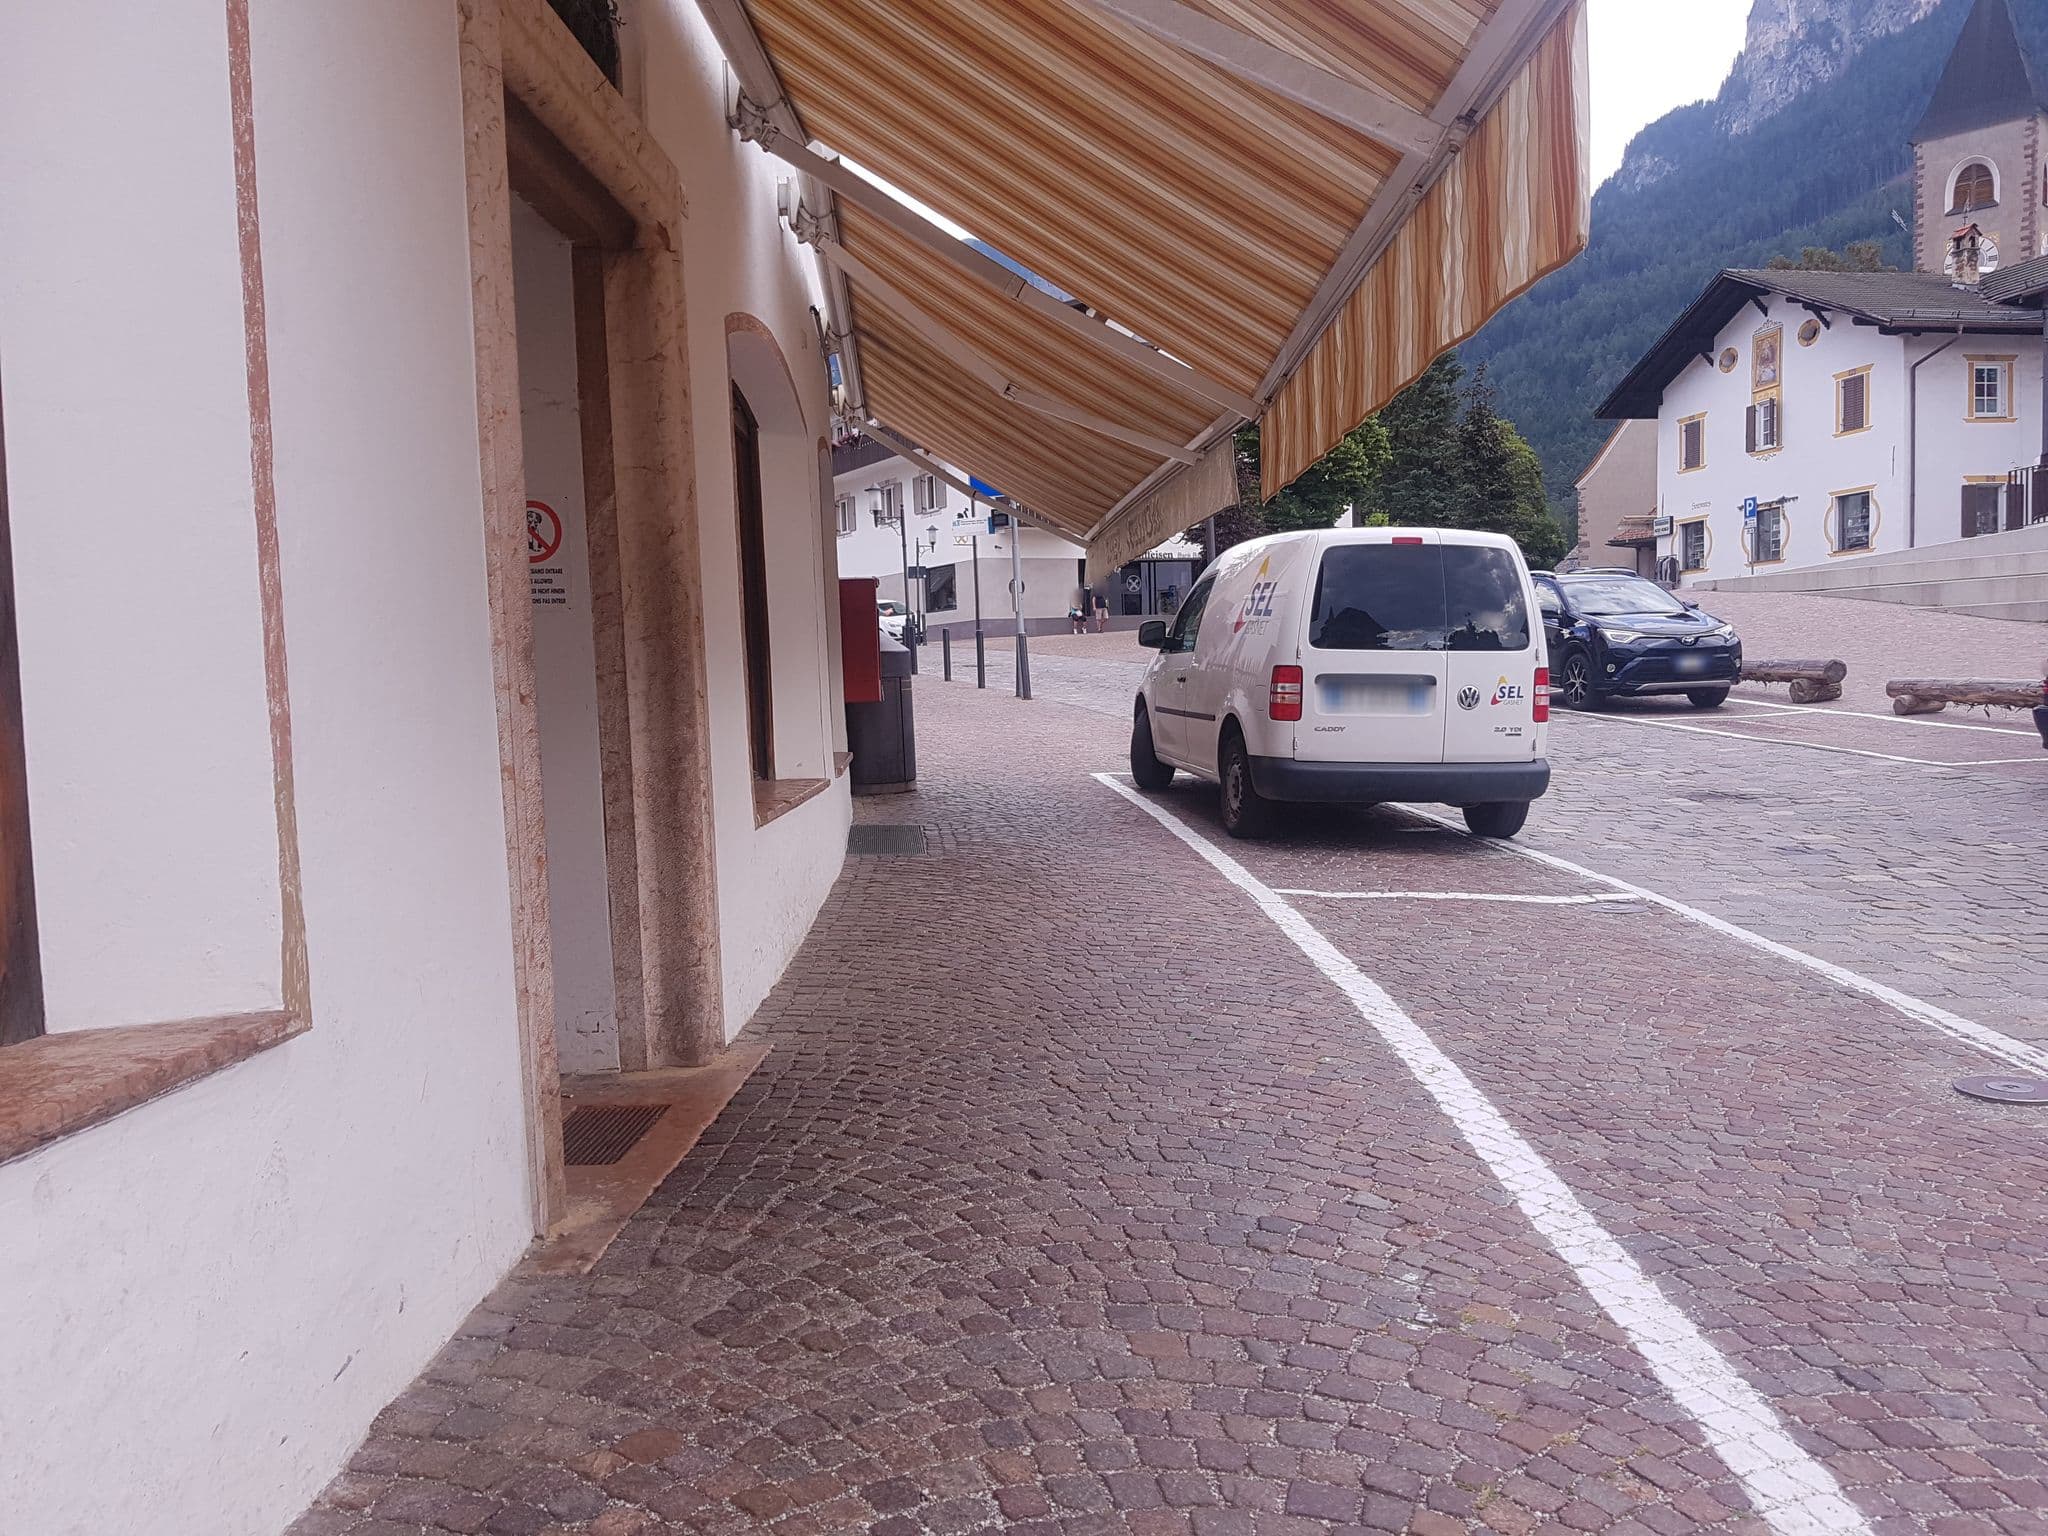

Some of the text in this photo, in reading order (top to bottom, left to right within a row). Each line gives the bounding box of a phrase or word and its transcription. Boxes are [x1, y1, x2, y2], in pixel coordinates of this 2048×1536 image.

[1746, 499, 1754, 516] P
[1245, 582, 1278, 617] SEL
[1498, 685, 1524, 699] SEL
